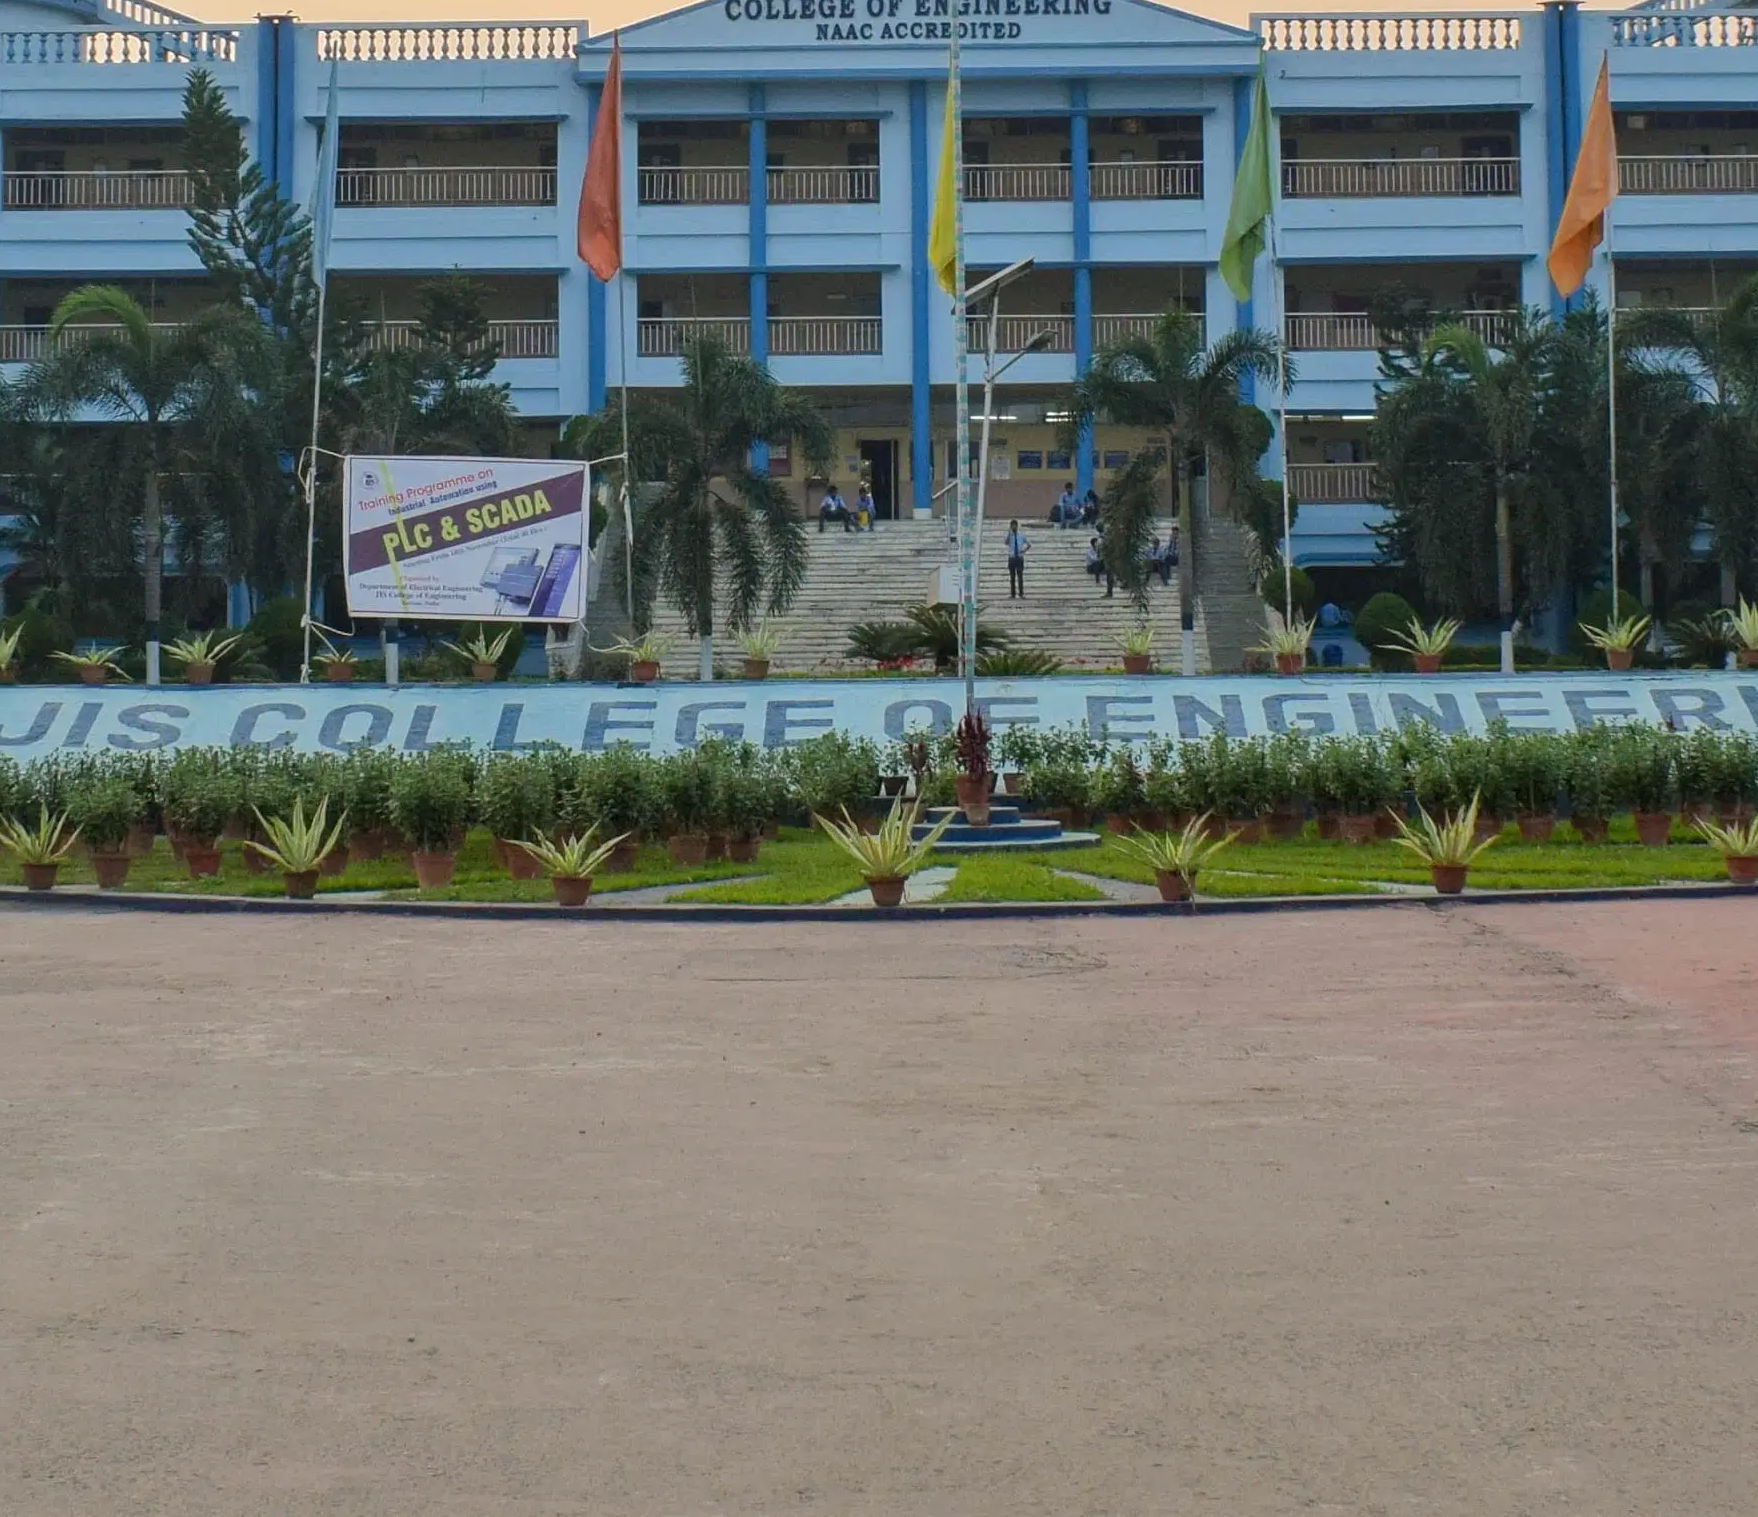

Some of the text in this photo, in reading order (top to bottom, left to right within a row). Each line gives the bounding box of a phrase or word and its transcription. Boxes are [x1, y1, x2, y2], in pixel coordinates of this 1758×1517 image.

[815, 21, 1022, 41] NAAC ACCREDITED
[358, 468, 494, 511] Training Programme on
[383, 489, 552, 559] PLC & SCADA
[228, 699, 835, 752] COLLEGE
[883, 695, 1041, 741] OF
